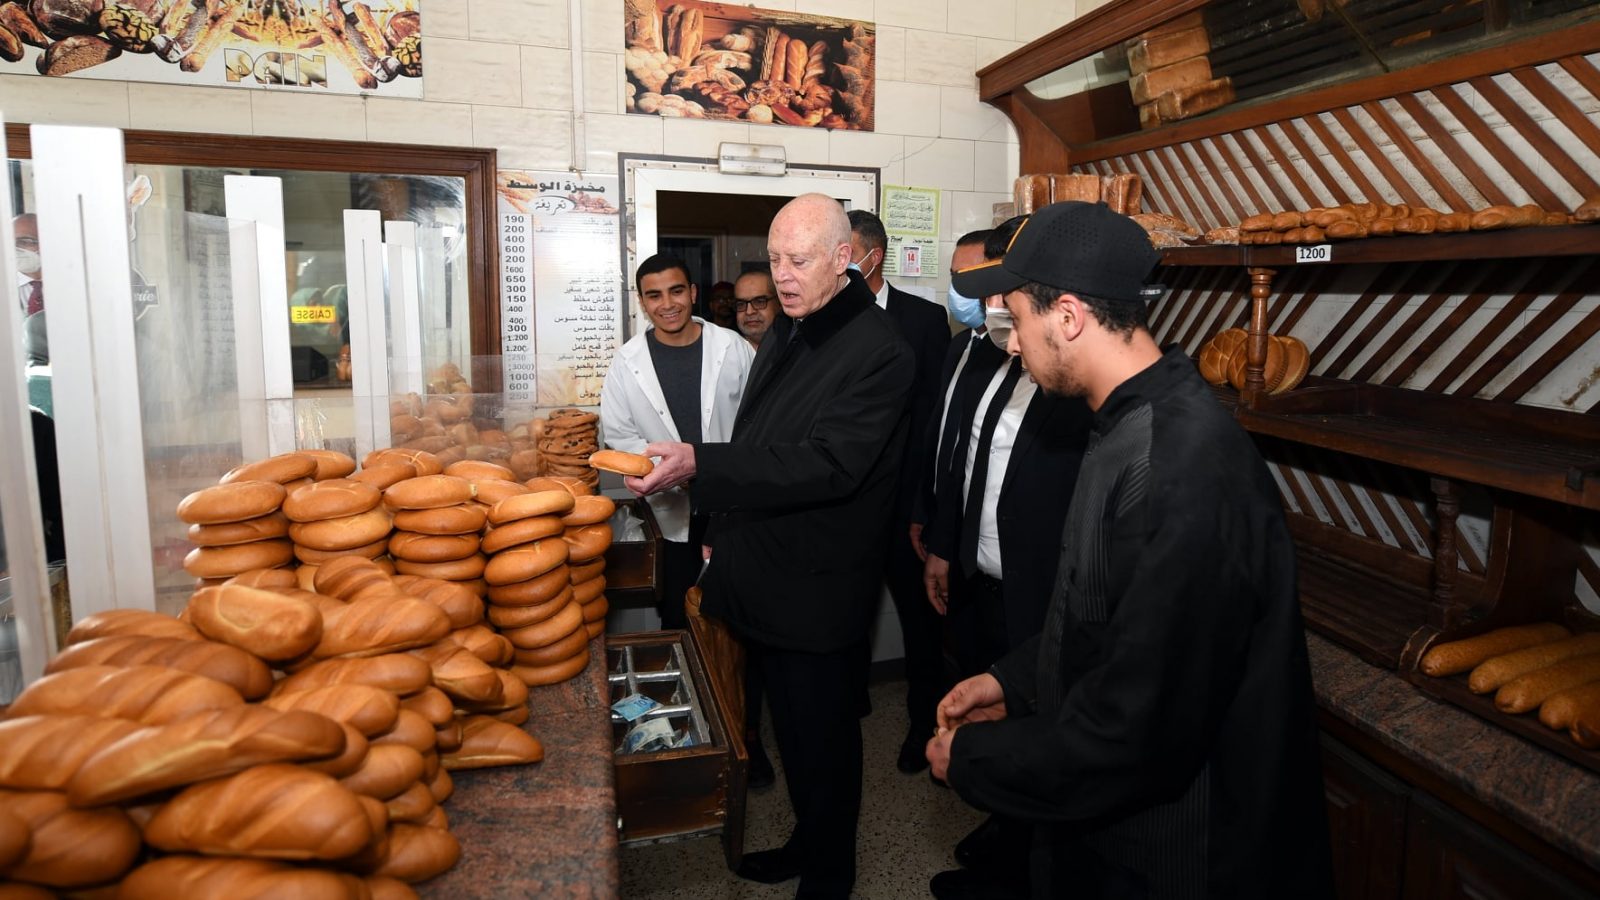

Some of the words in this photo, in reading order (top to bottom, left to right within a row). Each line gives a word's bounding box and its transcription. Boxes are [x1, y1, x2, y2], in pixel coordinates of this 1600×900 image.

[224, 48, 328, 88] PAIN
[507, 180, 560, 192] الوسط
[564, 180, 605, 193] مخبزة
[535, 198, 567, 216] تعريفة
[504, 215, 524, 223] 190
[504, 225, 524, 233] 200
[505, 235, 525, 243] 400
[505, 245, 525, 253] 600
[1300, 248, 1325, 258] 1200
[908, 253, 914, 262] 14
